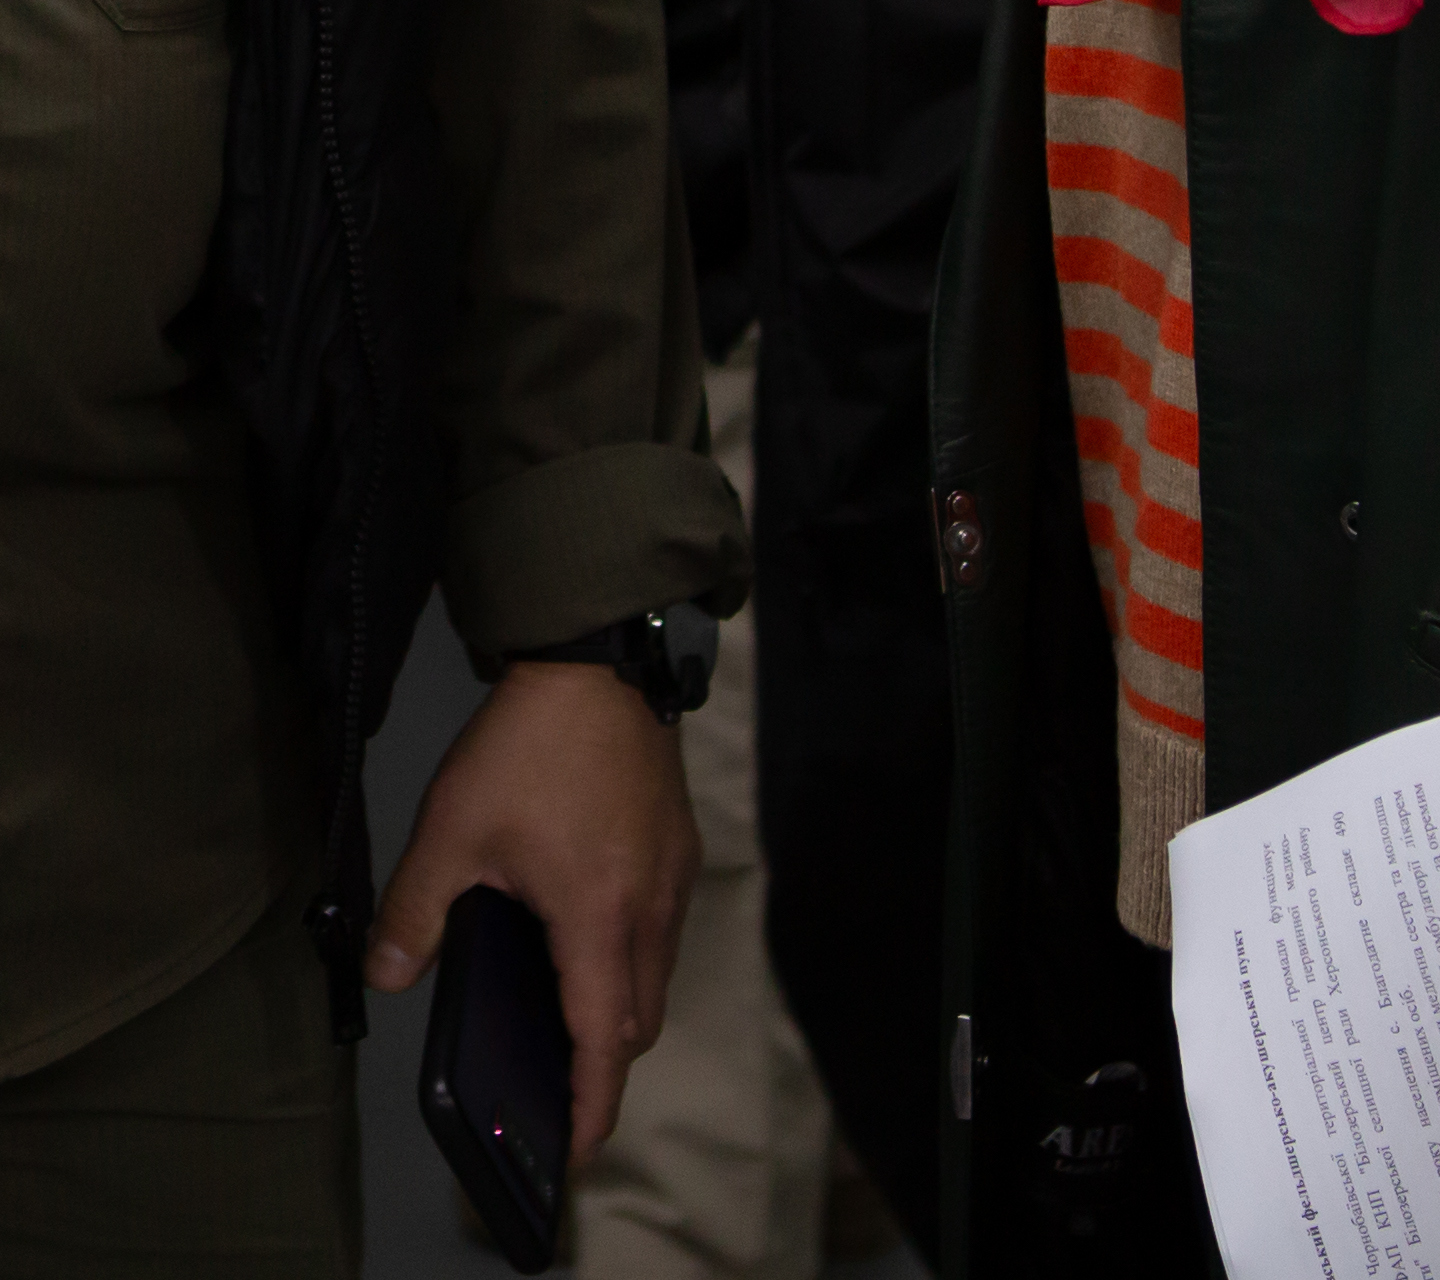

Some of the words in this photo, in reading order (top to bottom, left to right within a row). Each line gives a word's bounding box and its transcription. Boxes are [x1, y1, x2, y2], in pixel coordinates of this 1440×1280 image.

[1332, 811, 1347, 837] 490
[1374, 795, 1397, 866] молодша
[1393, 789, 1416, 848] лікарем
[1413, 782, 1439, 851] окремим
[1262, 843, 1284, 924] функціонує
[1281, 833, 1296, 891] медико-
[1299, 827, 1317, 877] району
[1342, 848, 1363, 907] складає
[1390, 869, 1402, 888] та
[1287, 905, 1316, 984] первинної
[1308, 888, 1343, 997] Херсонського
[1397, 891, 1419, 942] сестра
[1233, 930, 1251, 976] пункт
[1275, 938, 1301, 1003] громади
[1358, 919, 1393, 1010] Благодатне
[1312, 998, 1333, 1045] центр
[1338, 1008, 1361, 1047] ради
[1390, 1020, 1401, 1035] с.
[1398, 984, 1421, 1023] осіб.
[1239, 979, 1319, 1222] фельдшерсько-акушерський
[1291, 1018, 1337, 1138] територіальної
[1348, 1058, 1384, 1134] селищної
[1396, 1046, 1432, 1128] населення
[1326, 1060, 1371, 1175] "Білозерський
[1330, 1153, 1380, 1277] Чорнобаївської
[1366, 1189, 1392, 1231] КНП
[1376, 1145, 1422, 1247] Білозерської
